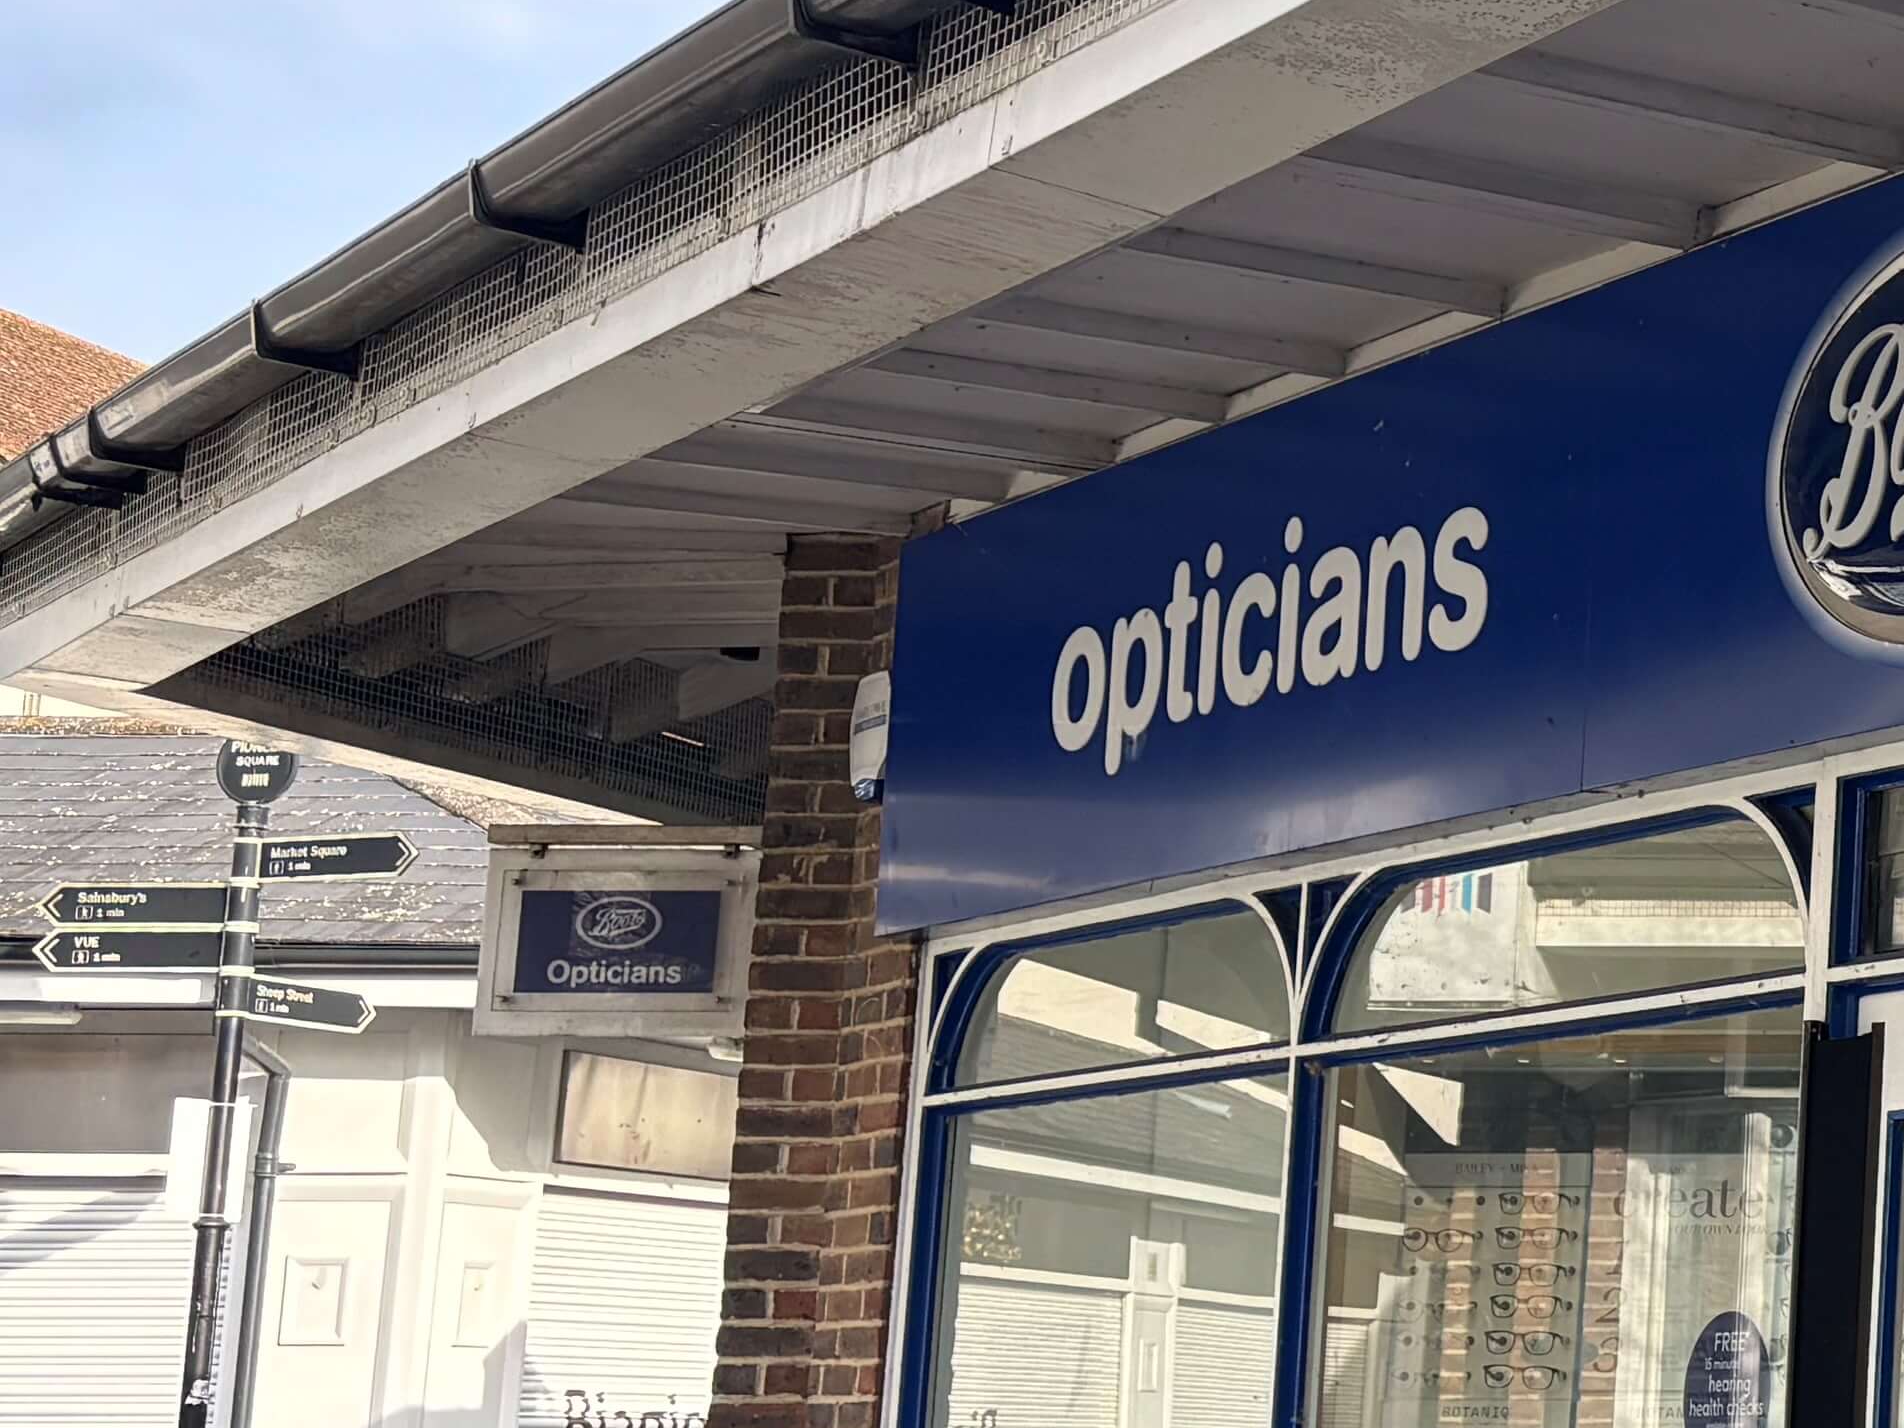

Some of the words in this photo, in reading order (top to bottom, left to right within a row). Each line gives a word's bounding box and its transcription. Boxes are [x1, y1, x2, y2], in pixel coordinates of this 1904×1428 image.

[1052, 507, 1488, 775] opticians
[236, 755, 280, 767] SQUARE
[270, 847, 308, 859] Market
[310, 845, 347, 859] Square
[78, 891, 147, 906] Sainsbury's
[106, 908, 124, 918] min
[588, 908, 647, 937] Boots
[74, 936, 99, 949] VUE
[547, 959, 681, 988] Opticians
[256, 985, 285, 1002] Sheep
[286, 989, 313, 1004] Street
[1708, 1373, 1751, 1399] hearing
[1441, 1406, 1510, 1419] BOTANIQ
[1688, 1398, 1724, 1417] health
[1726, 1398, 1764, 1418] checks
